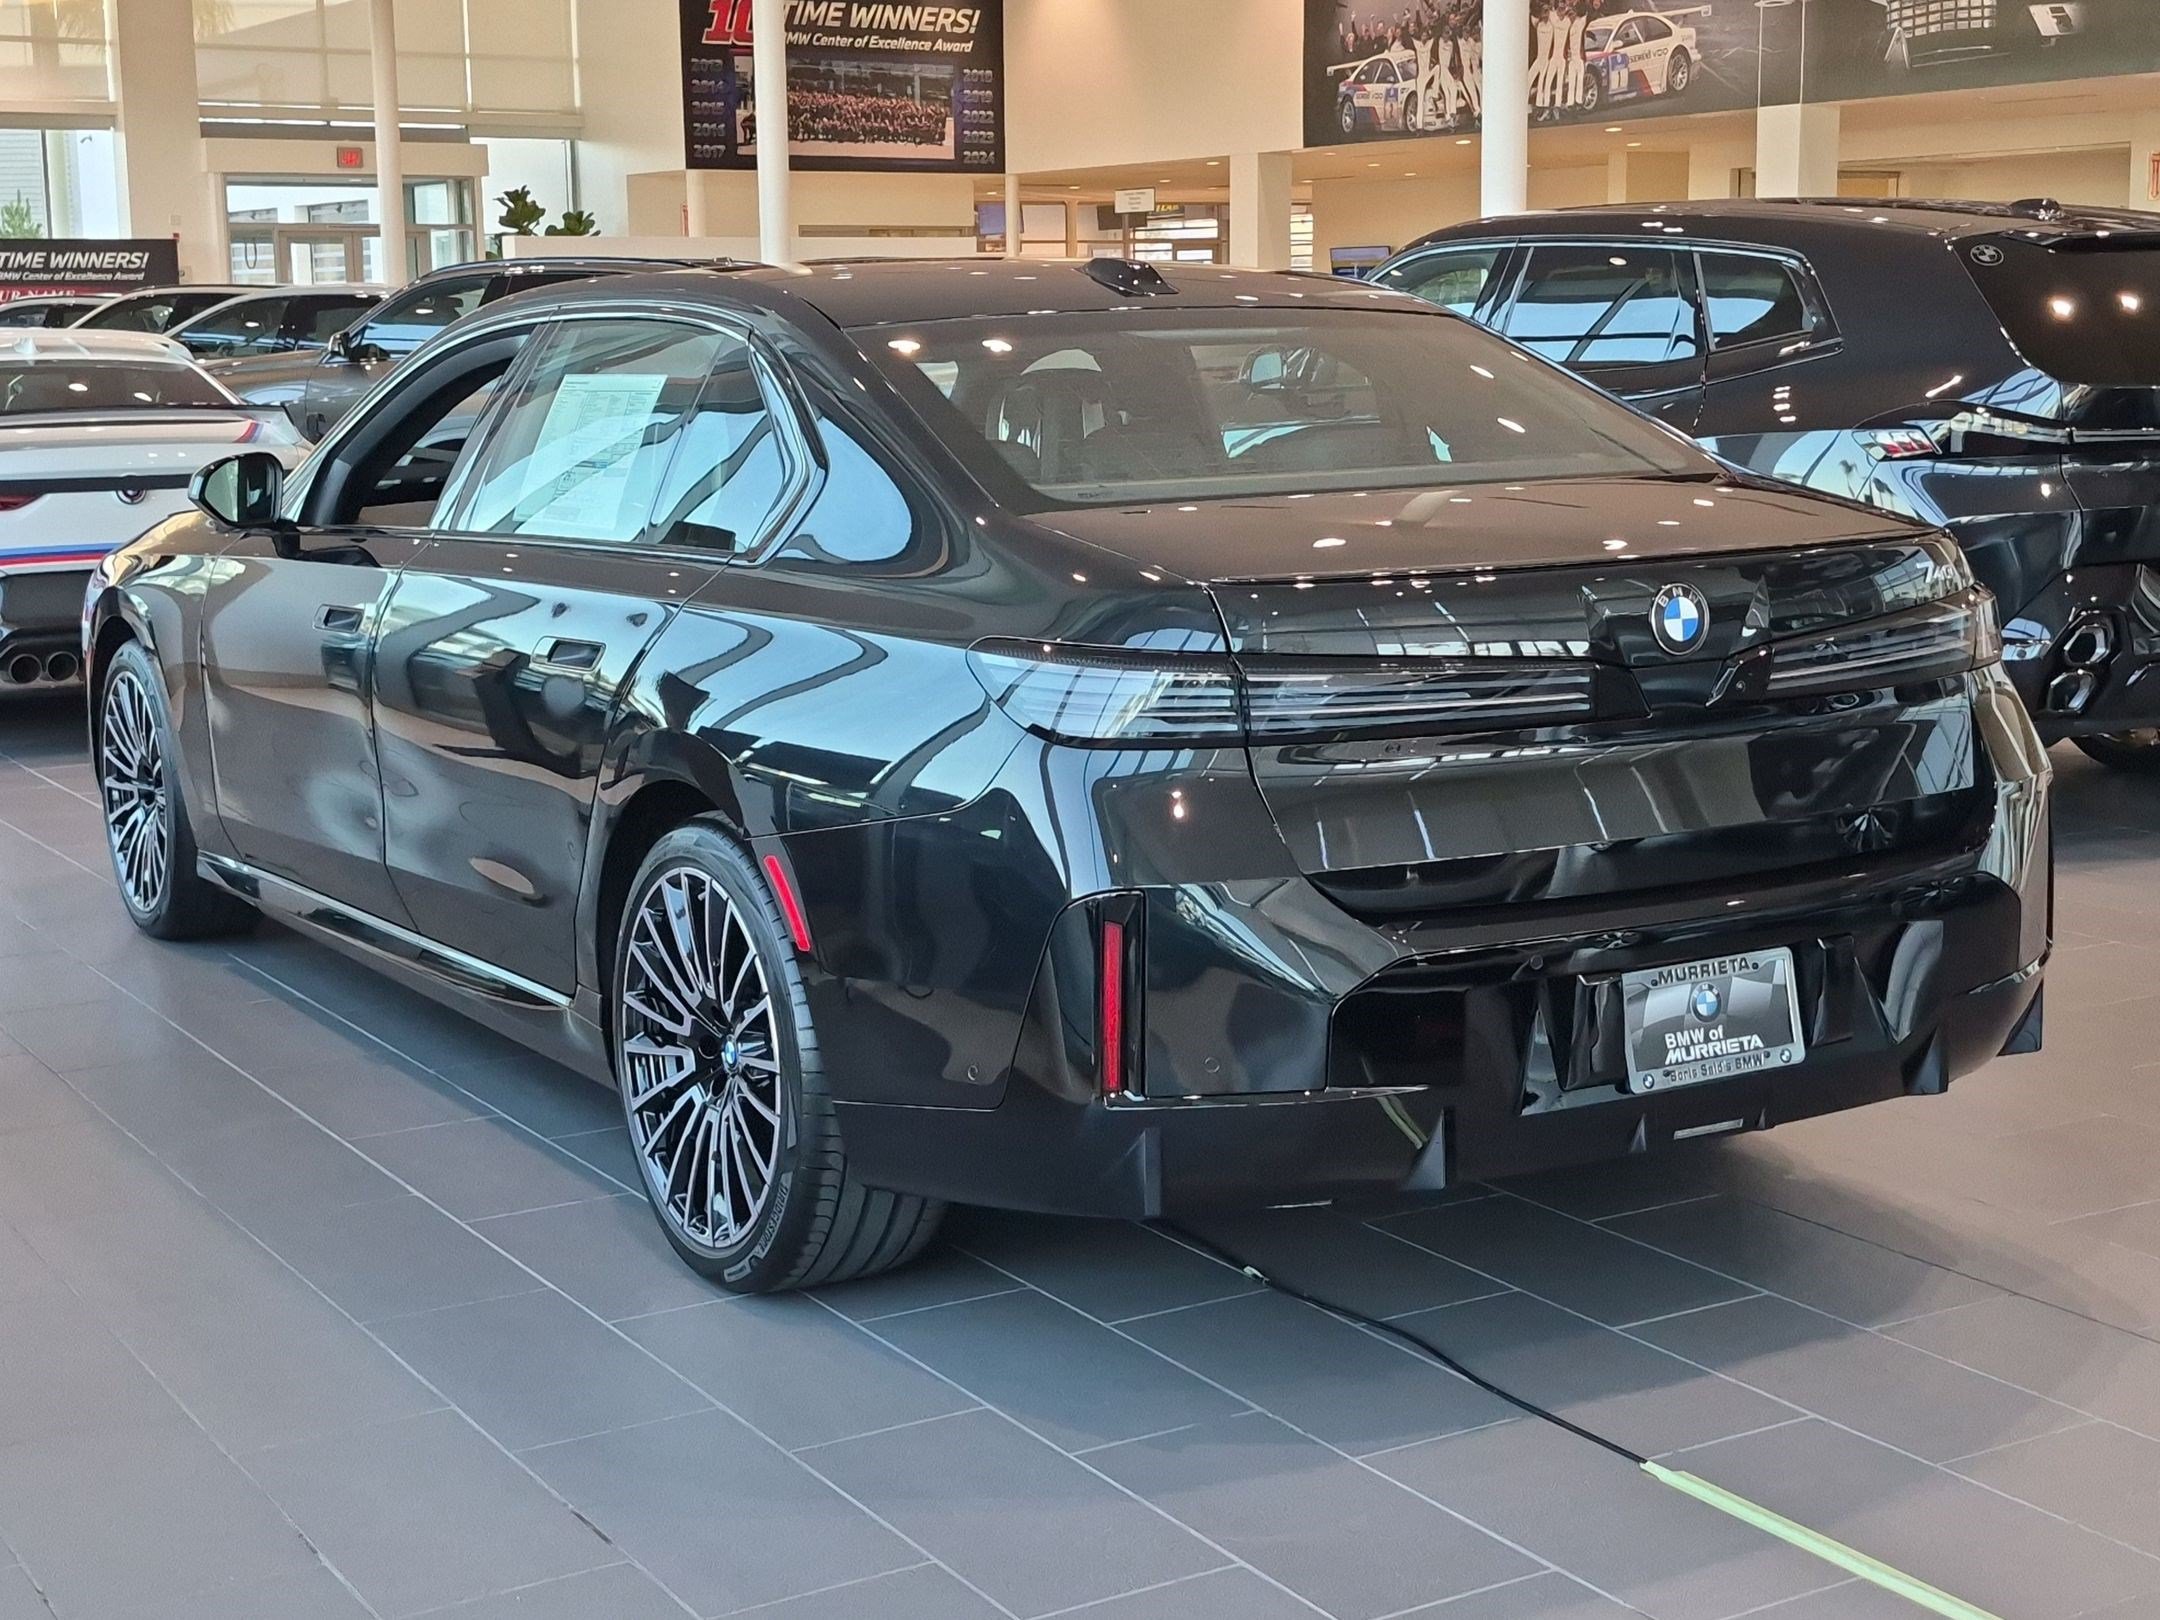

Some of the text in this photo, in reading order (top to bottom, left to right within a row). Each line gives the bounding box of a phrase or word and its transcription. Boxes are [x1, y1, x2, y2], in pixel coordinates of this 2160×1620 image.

[785, 1, 846, 27] TIME
[850, 3, 980, 34] WINNERS!
[785, 32, 975, 52] MW Center of Excellence Award
[962, 110, 995, 124] 2022
[963, 130, 995, 144] 2023
[693, 144, 726, 158] 2017
[963, 151, 996, 164] 2024
[0, 252, 150, 269] TIME WINNERS!
[22, 271, 54, 281] Center
[54, 271, 65, 281] of
[65, 271, 113, 281] Excellence
[113, 271, 145, 281] Award
[1658, 587, 1699, 607] BMW
[1657, 957, 1750, 985] MURRIETA
[1664, 1024, 1724, 1049] BMW of
[1664, 1034, 1764, 1066] MURRIETA
[1735, 1053, 1764, 1070] BMW
